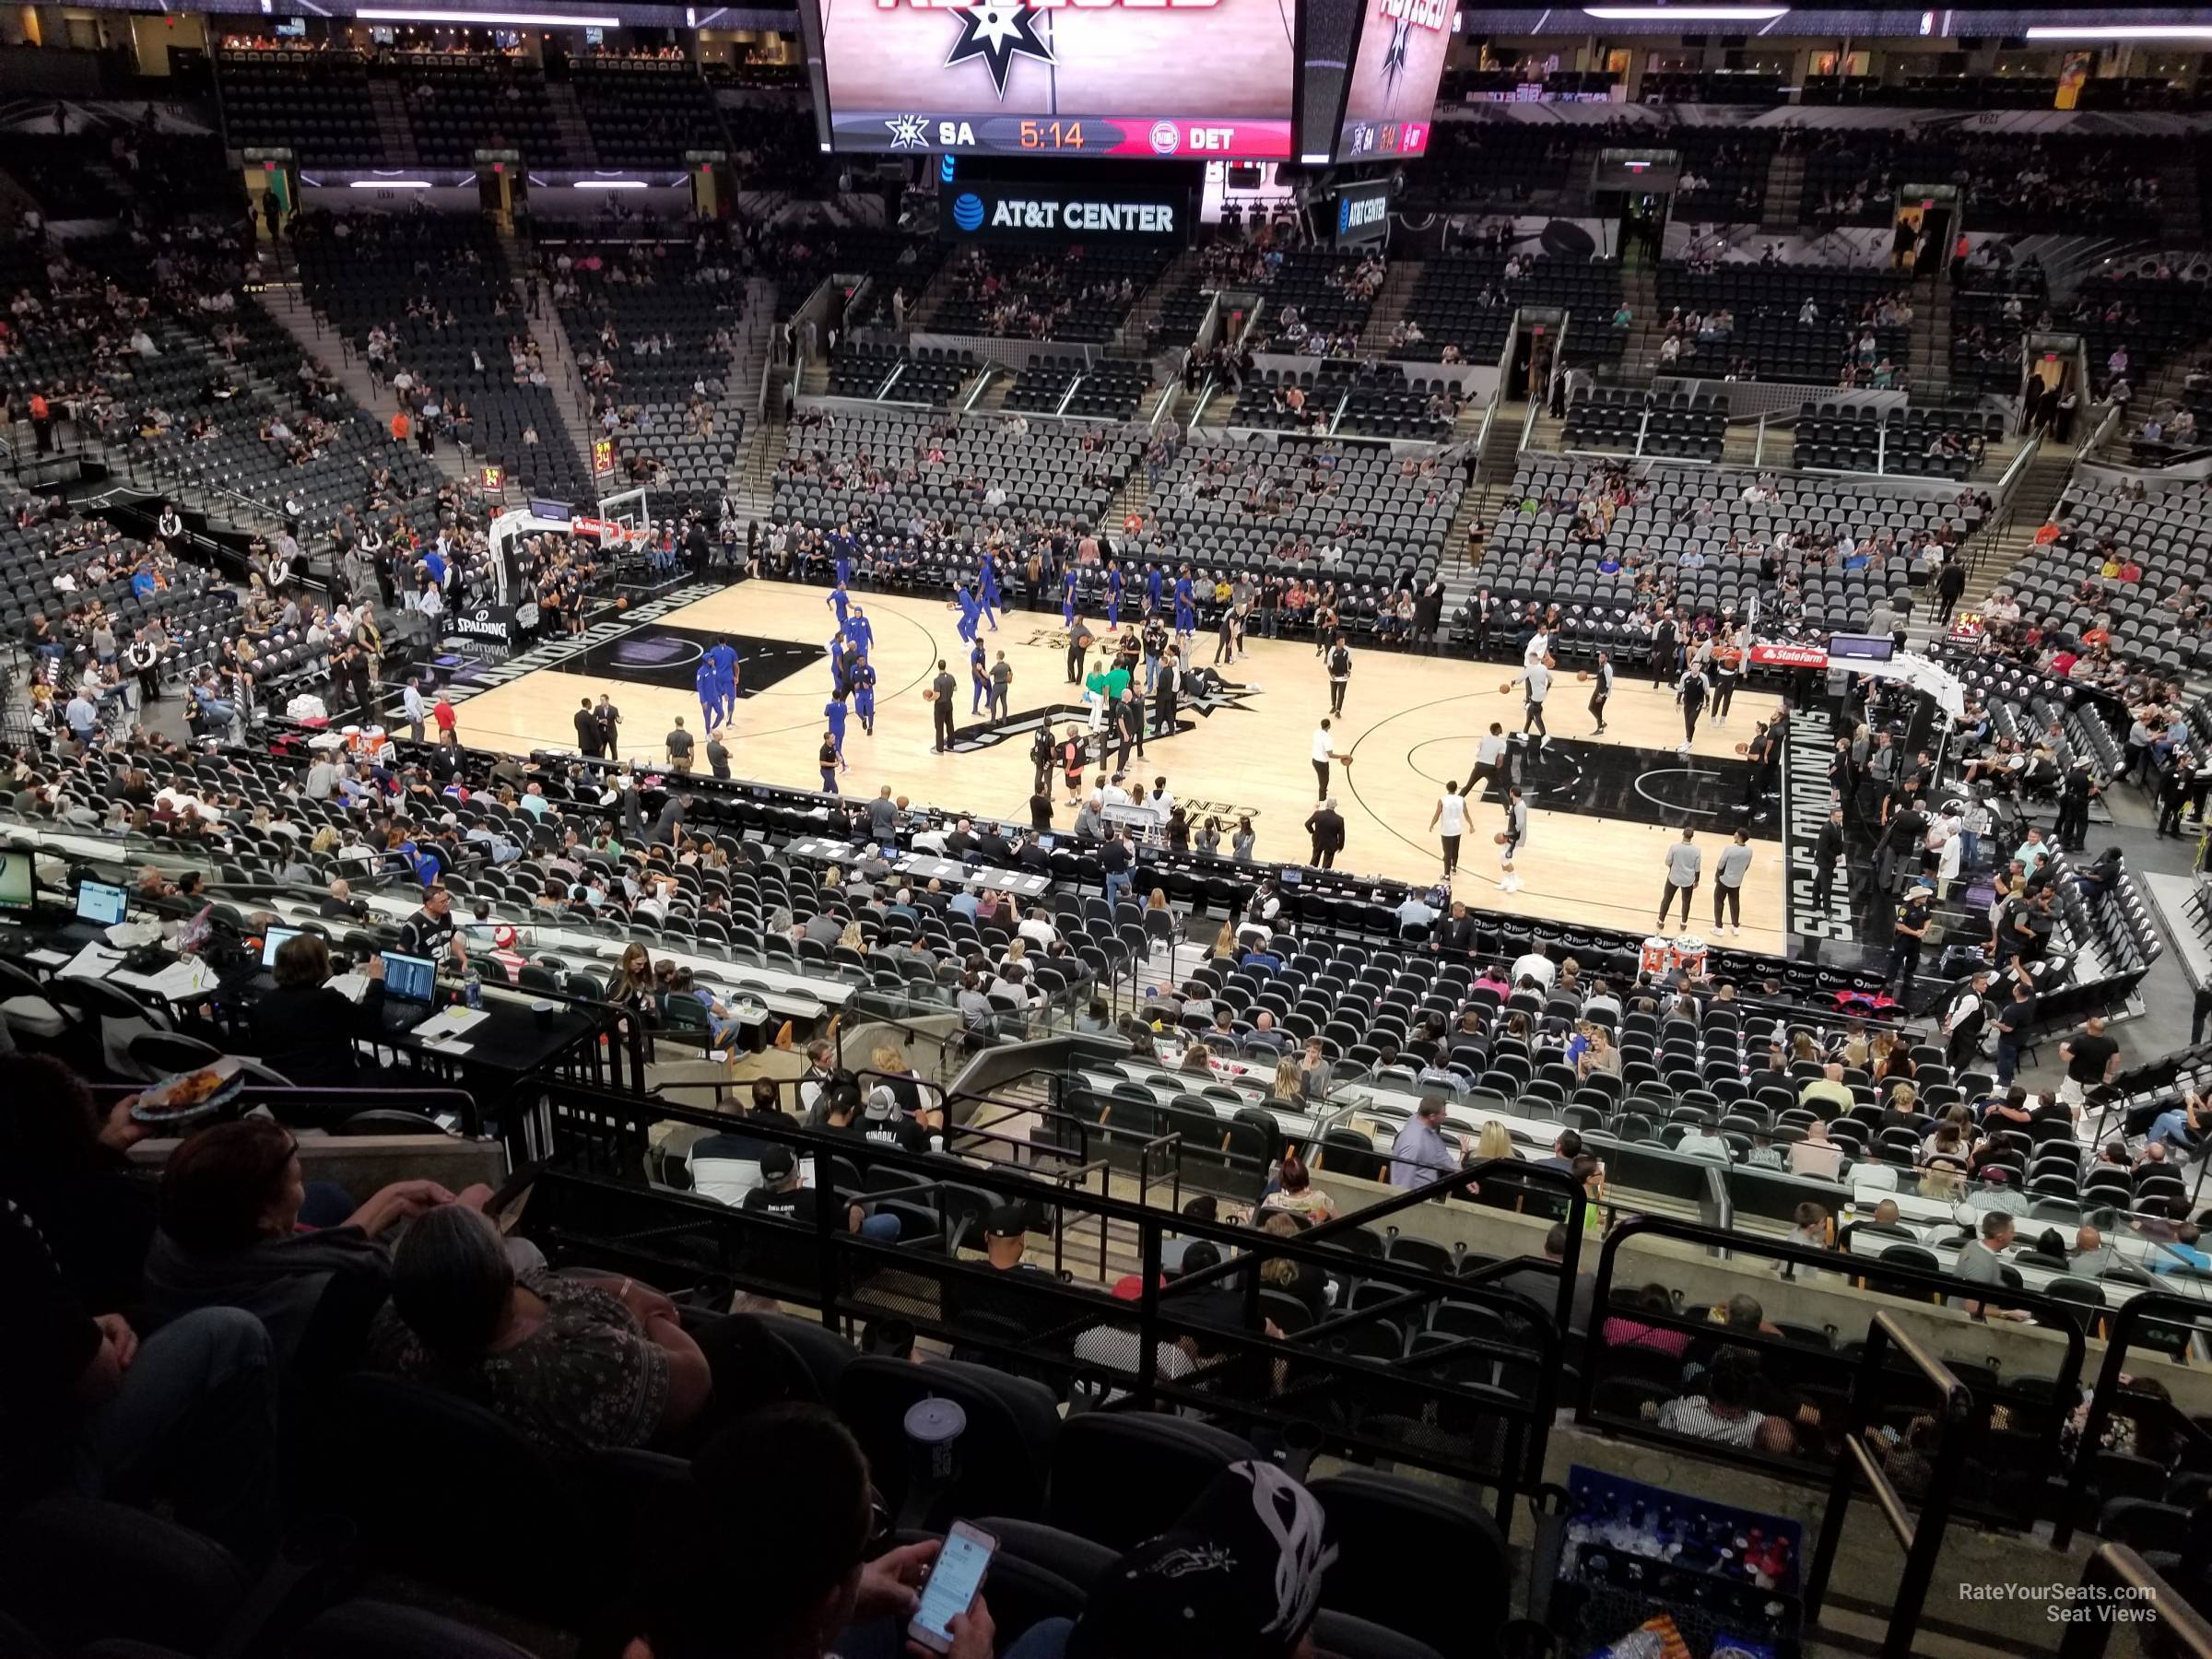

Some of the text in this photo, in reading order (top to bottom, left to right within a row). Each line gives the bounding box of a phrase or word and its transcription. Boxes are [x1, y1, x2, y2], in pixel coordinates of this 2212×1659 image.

[938, 122, 976, 146] SA
[1020, 120, 1084, 148] 5:14
[1190, 127, 1235, 150] DET
[991, 200, 1173, 232] AT&T CENTER
[1364, 196, 1386, 224] CENTER
[457, 617, 507, 638] SPALDING
